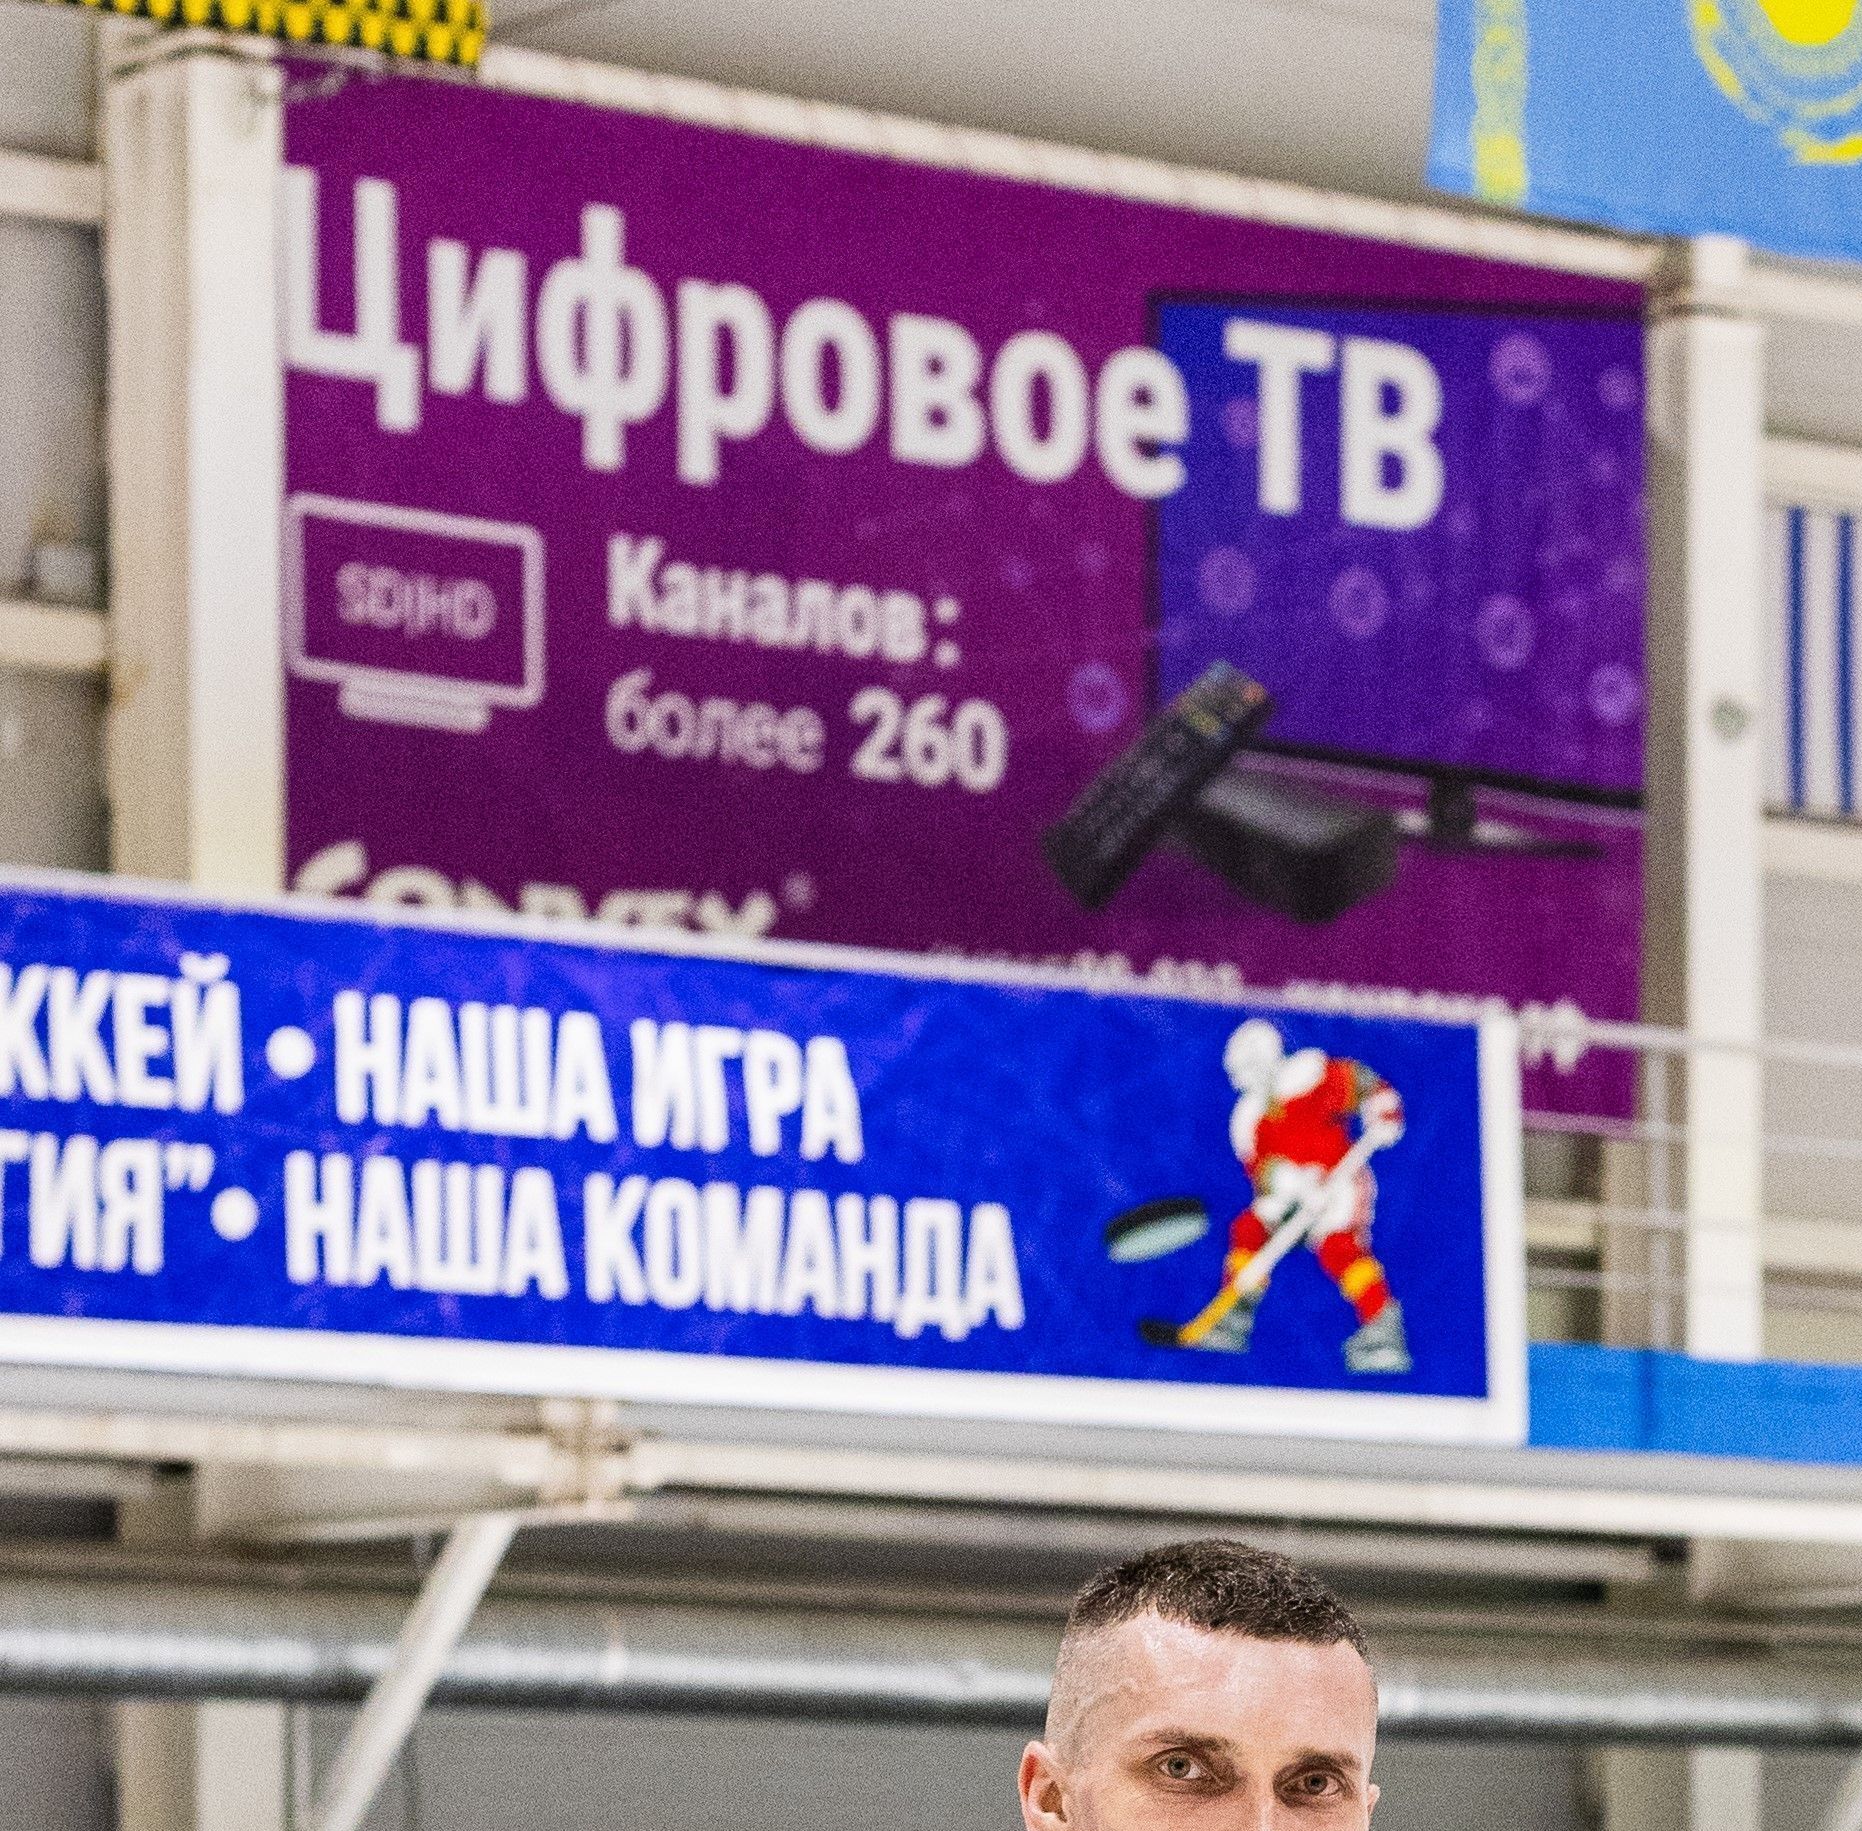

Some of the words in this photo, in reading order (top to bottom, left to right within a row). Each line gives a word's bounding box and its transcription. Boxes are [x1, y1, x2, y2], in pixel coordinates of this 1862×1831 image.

[284, 164, 1191, 501] Цифровое
[1223, 317, 1445, 531] ТВ
[606, 534, 962, 668] Каналов:
[604, 668, 826, 773] более
[849, 687, 1008, 792] 260
[332, 989, 618, 1144] НАША
[630, 1017, 863, 1164] ИГРА
[284, 1149, 569, 1301] НАША
[583, 1172, 1025, 1341] КОМАНДА
